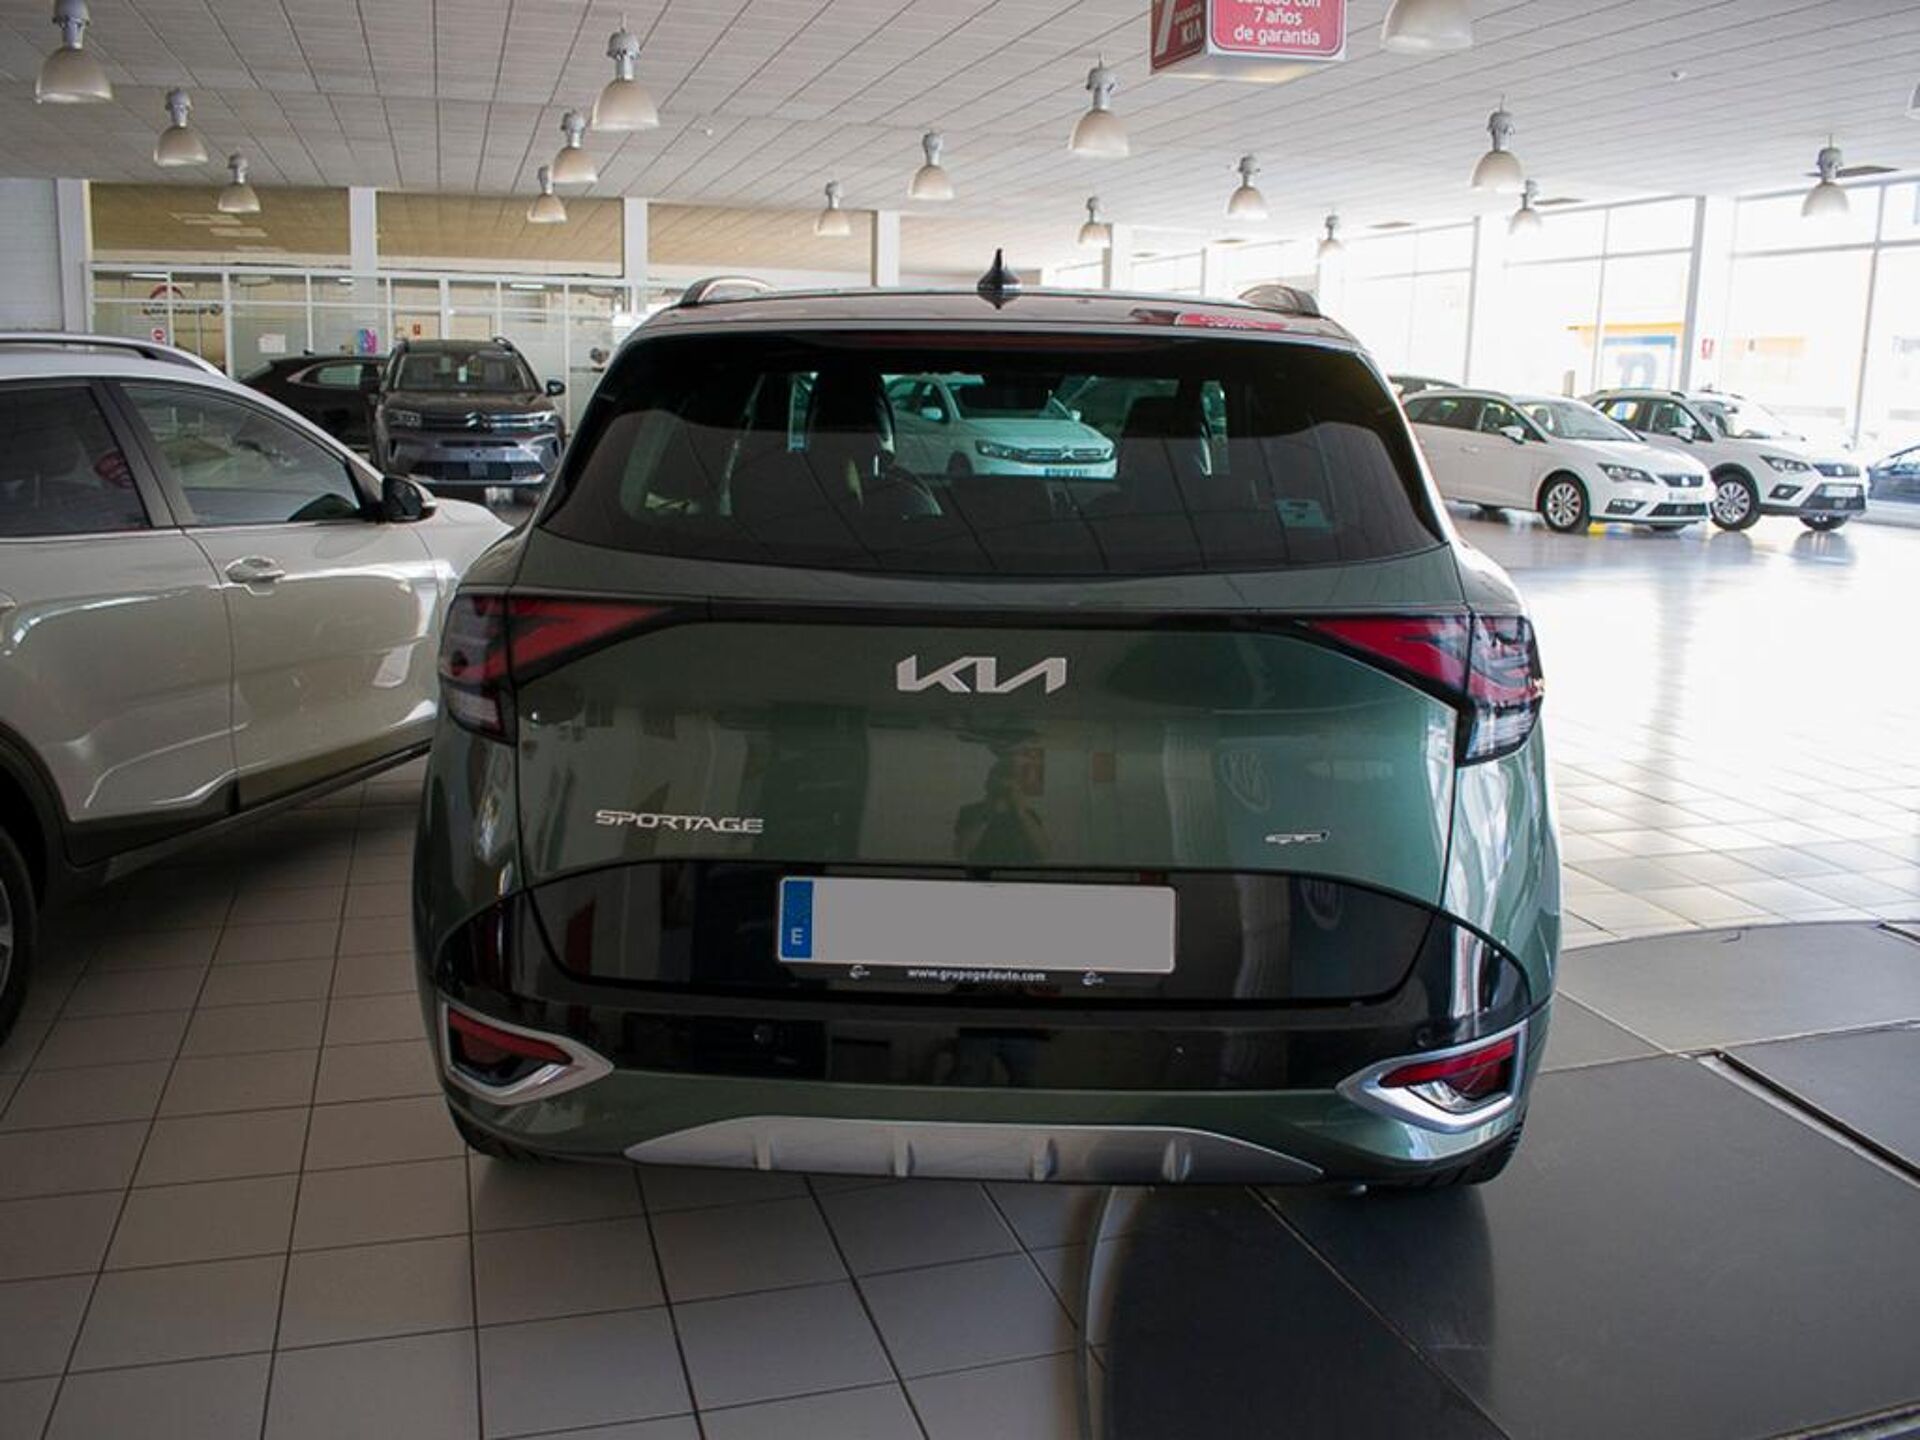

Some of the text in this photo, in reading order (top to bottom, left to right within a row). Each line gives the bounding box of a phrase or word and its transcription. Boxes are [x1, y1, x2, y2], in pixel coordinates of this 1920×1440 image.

[1254, 7, 1302, 26] 7 años
[1234, 24, 1320, 45] de garantía
[896, 655, 1066, 694] KIA
[595, 809, 764, 834] SPORTAGE
[791, 927, 804, 945] E
